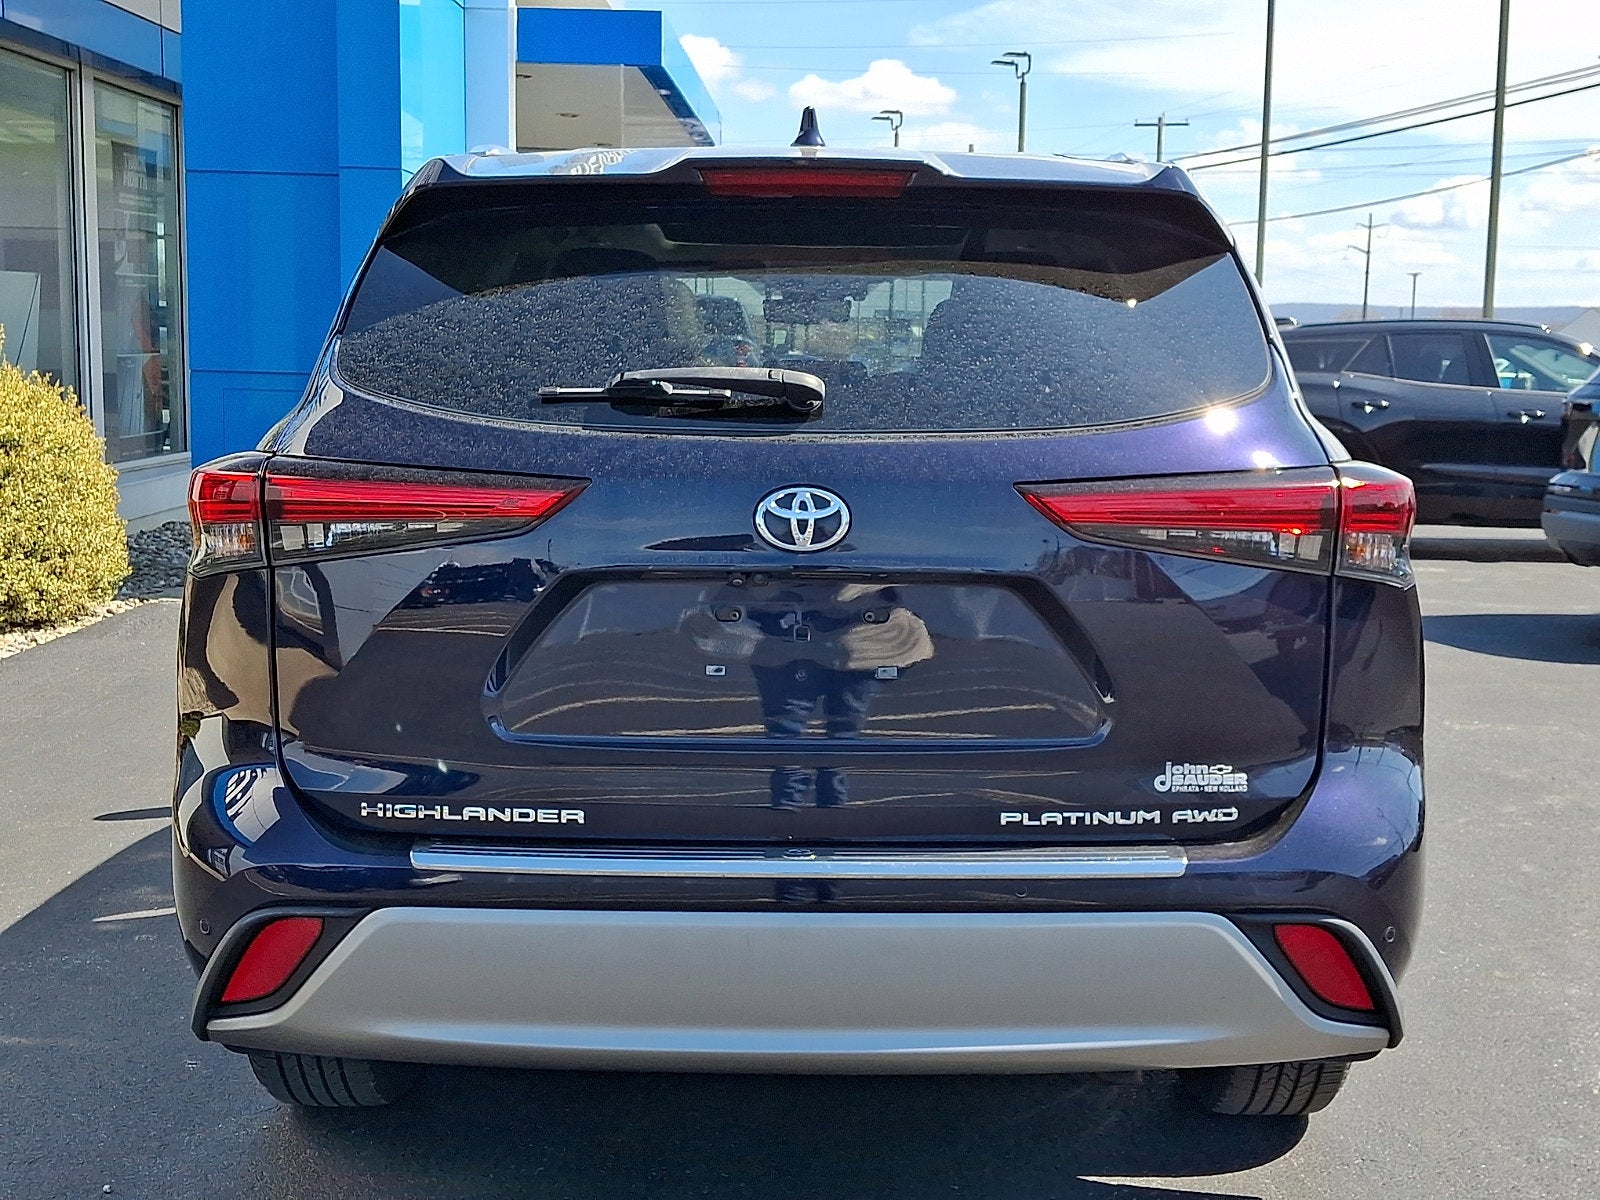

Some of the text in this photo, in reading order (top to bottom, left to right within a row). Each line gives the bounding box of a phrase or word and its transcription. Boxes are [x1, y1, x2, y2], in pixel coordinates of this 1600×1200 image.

[1172, 773, 1248, 786] SAUDER
[1204, 785, 1218, 793] NEW
[360, 801, 585, 824] HIGHLANDER
[1000, 806, 1239, 826] PLATINUM AWD
